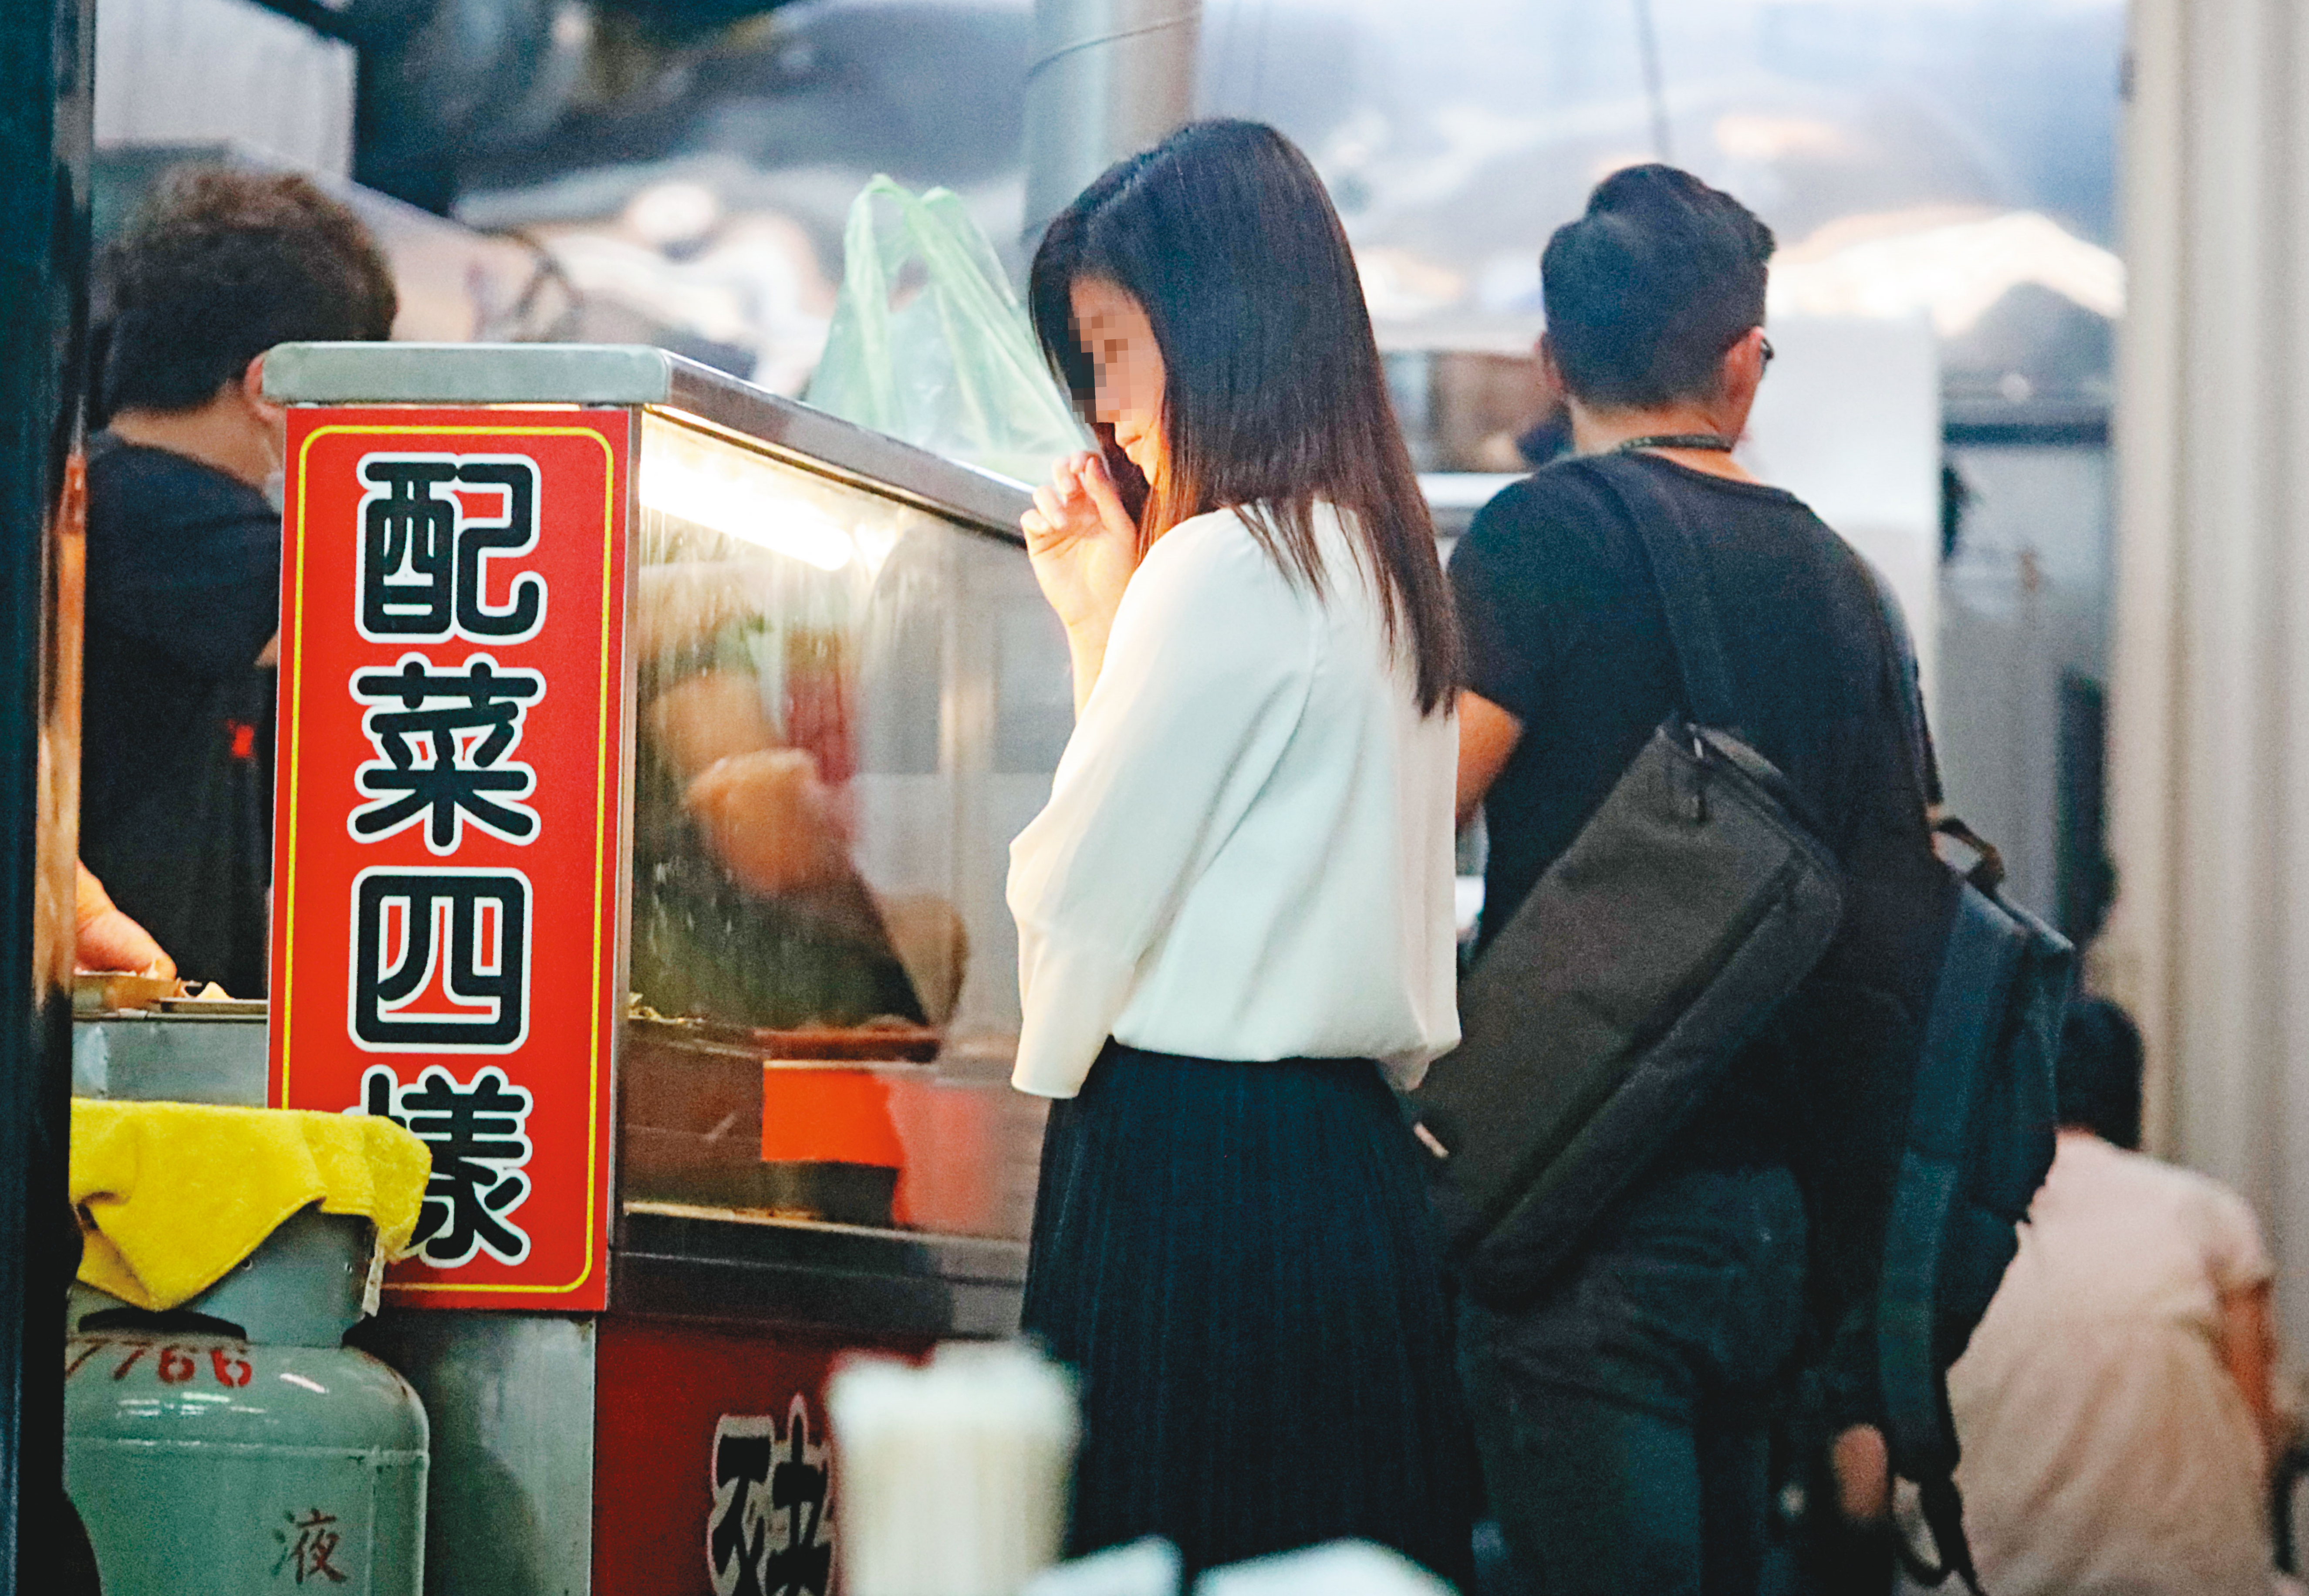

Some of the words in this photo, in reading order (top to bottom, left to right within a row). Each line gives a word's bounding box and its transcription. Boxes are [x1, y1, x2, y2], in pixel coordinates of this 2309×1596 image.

[349, 452, 548, 1266] 配菜四樣
[272, 1508, 347, 1584] 液
